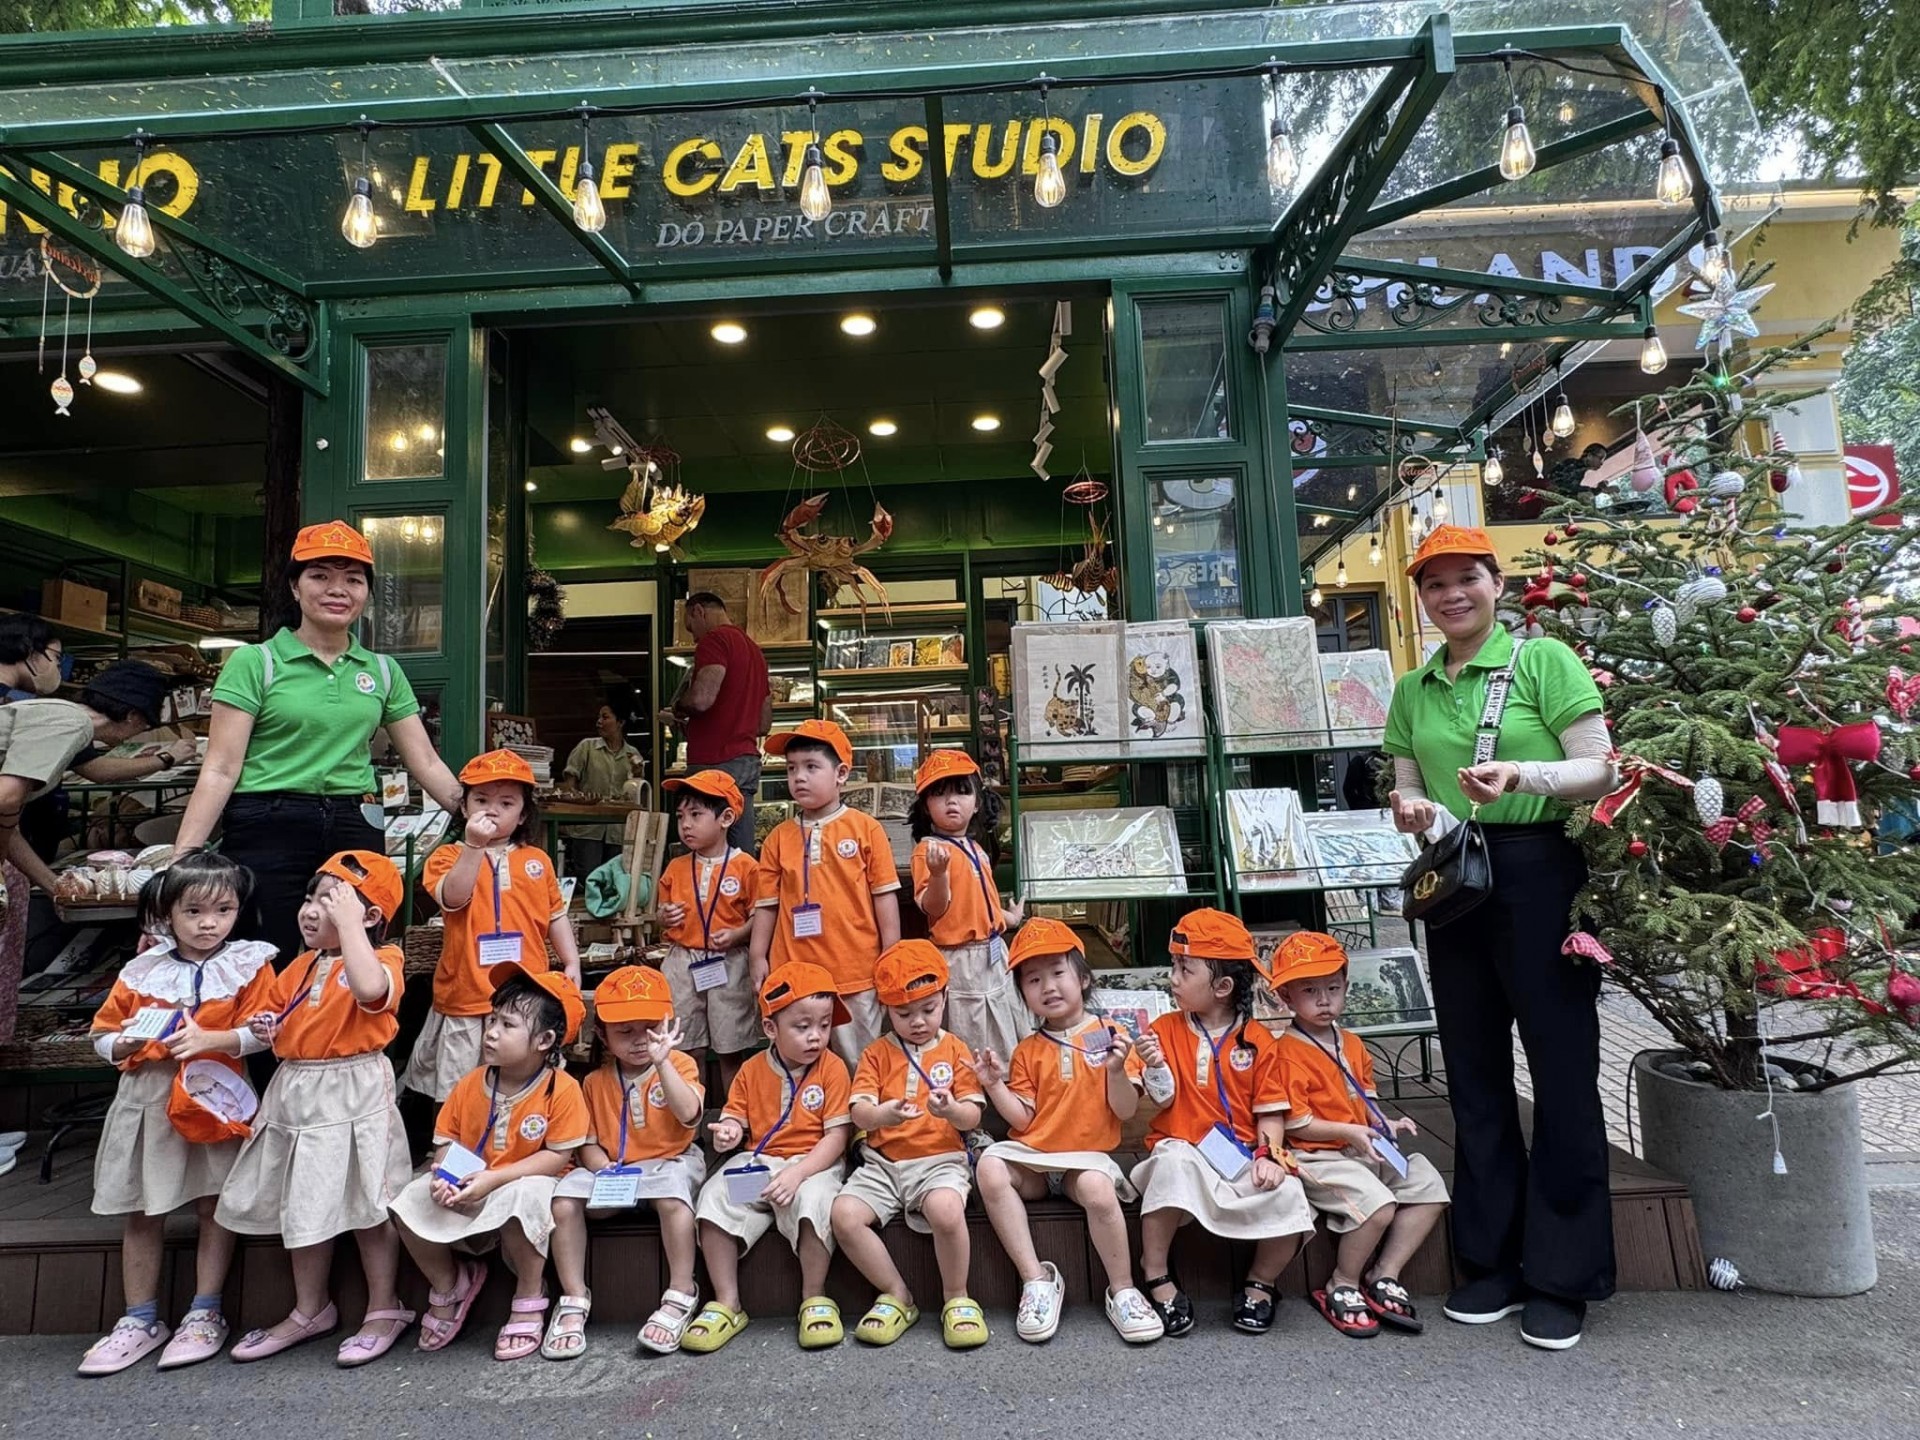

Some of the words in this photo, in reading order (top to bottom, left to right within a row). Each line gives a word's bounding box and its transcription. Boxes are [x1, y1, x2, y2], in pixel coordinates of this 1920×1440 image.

[405, 143, 639, 211] LITTLE
[663, 129, 863, 197] CATS
[880, 111, 1167, 182] STUDIO
[713, 211, 815, 245] PAPER
[824, 204, 934, 239] CRAFT
